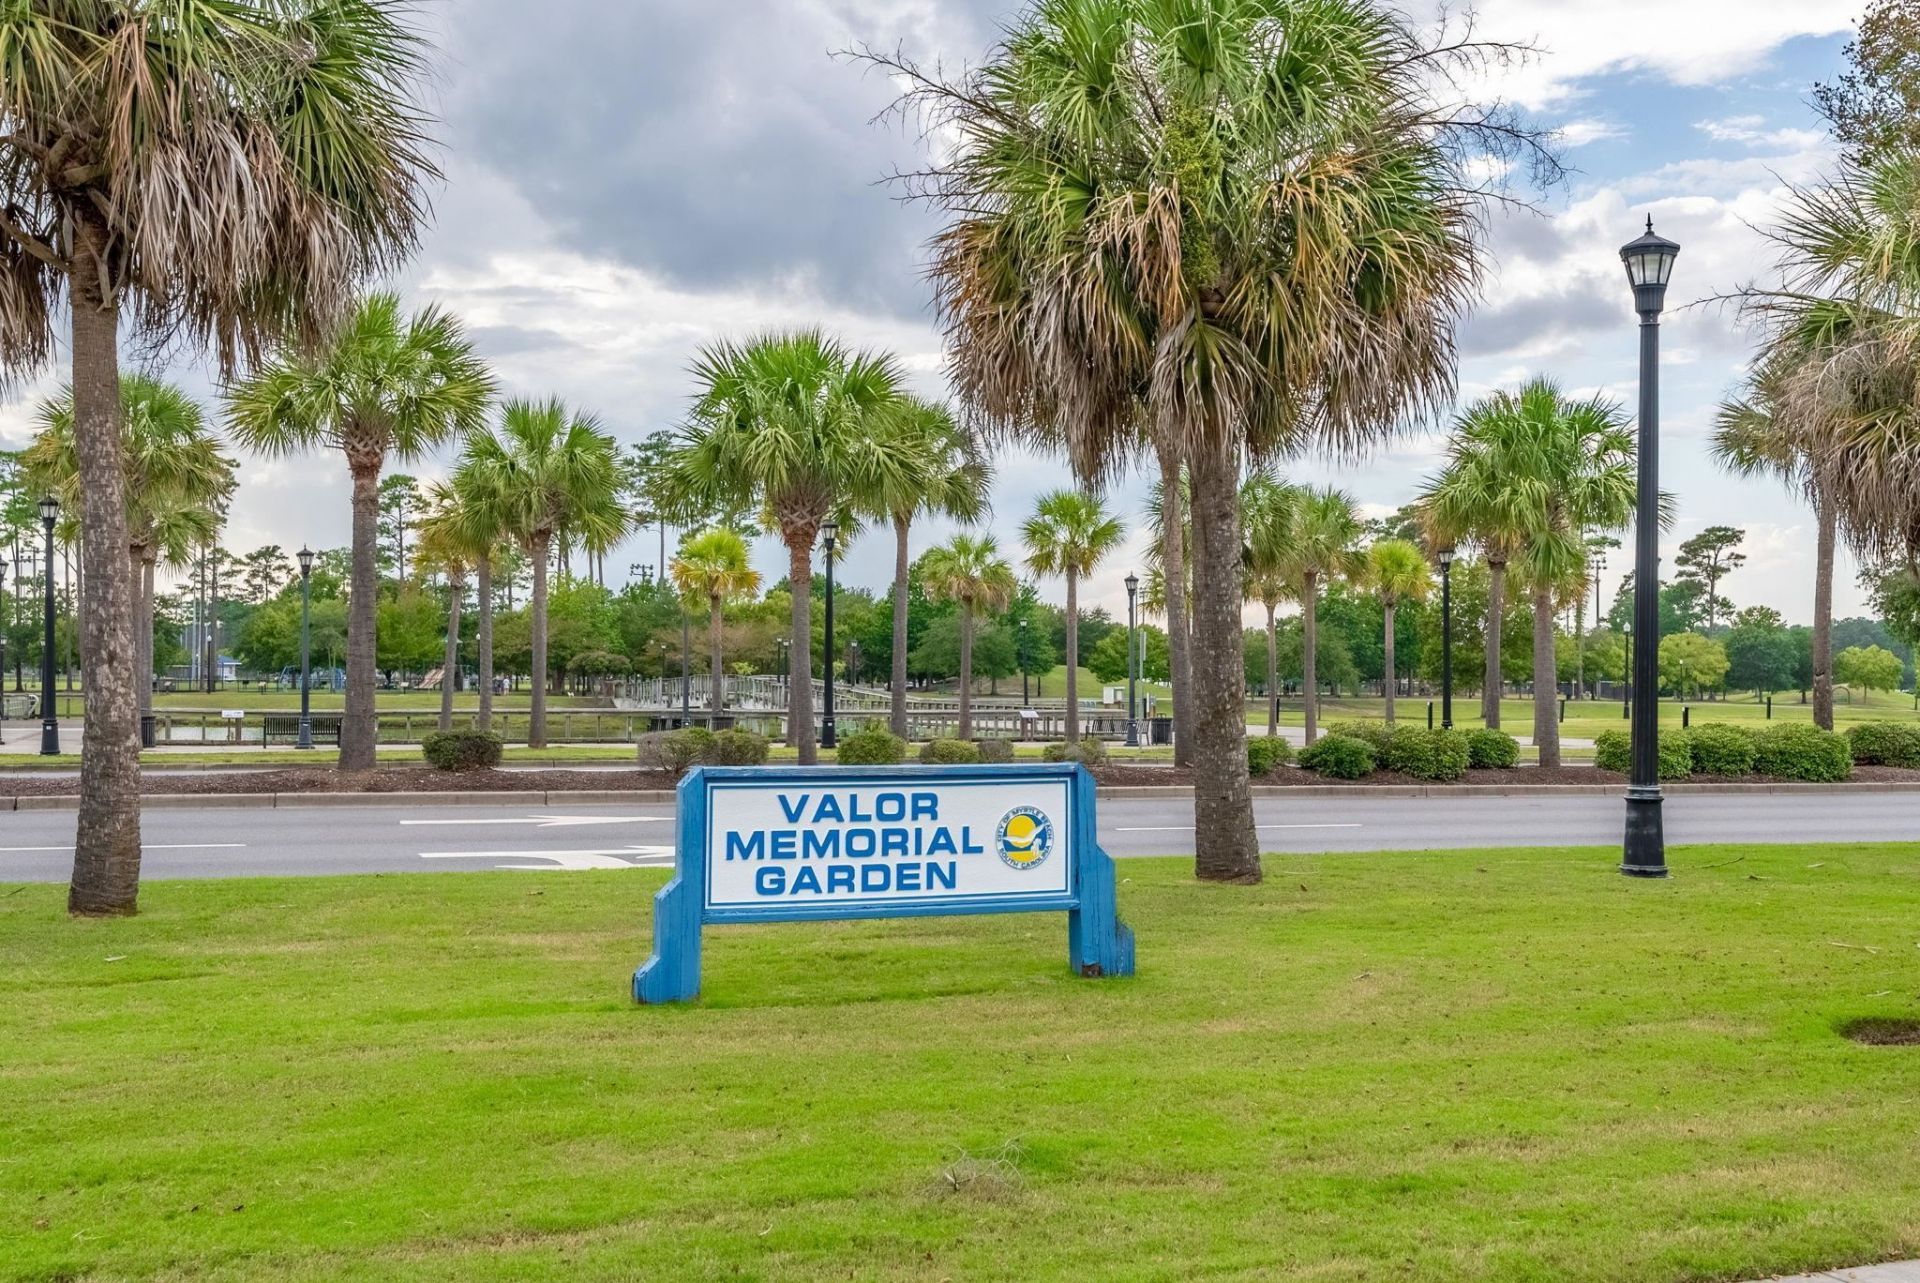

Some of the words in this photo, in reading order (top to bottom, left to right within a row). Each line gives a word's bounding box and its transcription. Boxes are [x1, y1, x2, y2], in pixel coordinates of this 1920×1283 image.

[778, 793, 939, 823] VALOR
[997, 824, 1005, 842] CITY
[1003, 813, 1011, 823] OF
[1012, 807, 1041, 816] MYRTLE
[726, 827, 984, 861] MEMORIAL
[999, 847, 1019, 867] SOUTH
[1021, 845, 1050, 868] CAROLINA
[756, 862, 957, 896] GARDEN
